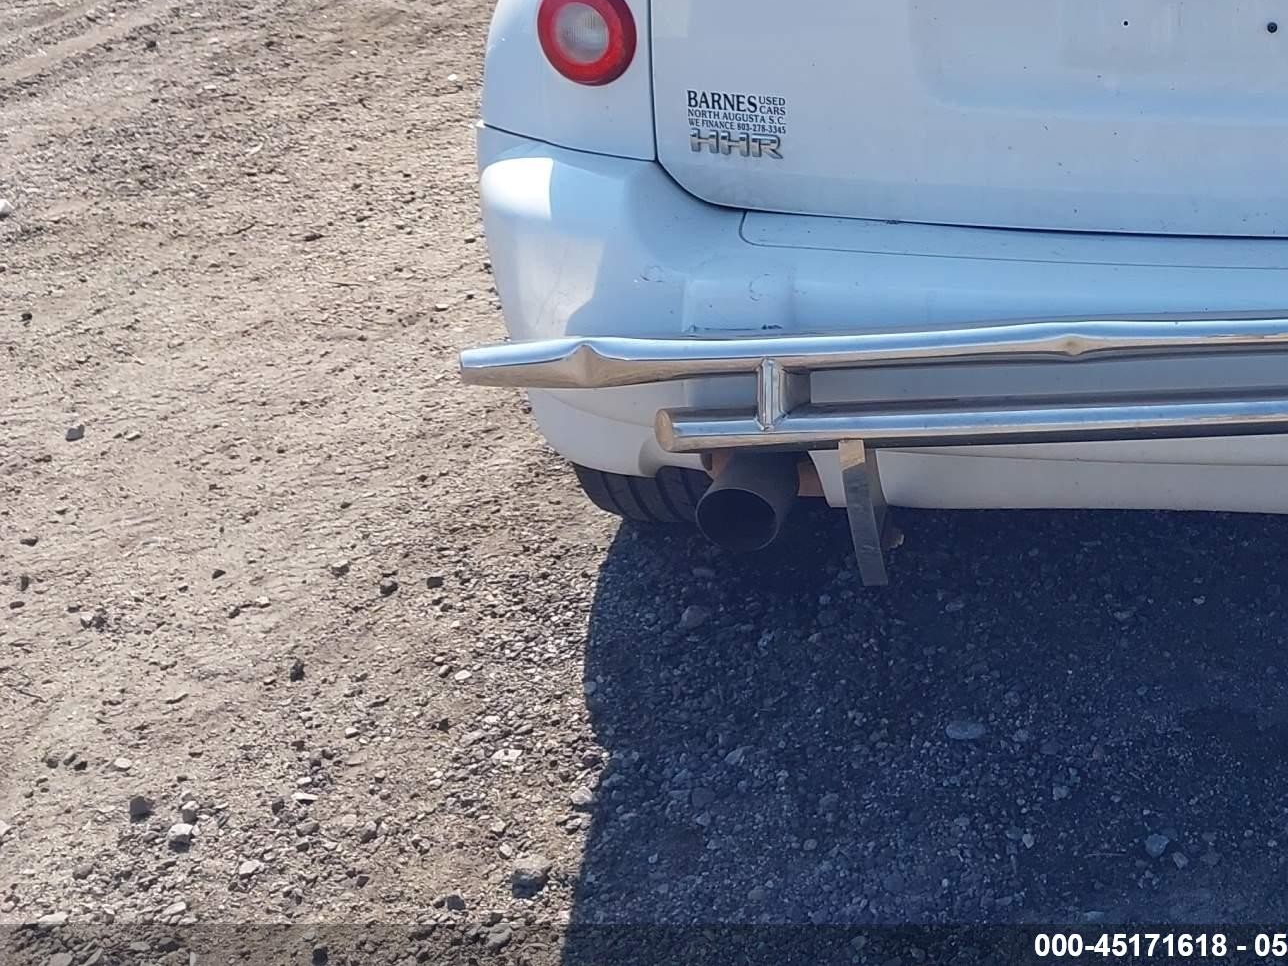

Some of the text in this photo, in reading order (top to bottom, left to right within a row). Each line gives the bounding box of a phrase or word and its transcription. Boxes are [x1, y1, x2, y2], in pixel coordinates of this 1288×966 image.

[687, 90, 786, 113] BARNES USED
[687, 108, 786, 125] NORTH AUGUSTA S.C.
[759, 105, 786, 116] CARS
[688, 118, 786, 134] WE FINANCE 803-278-3345
[690, 127, 784, 160] HHR
